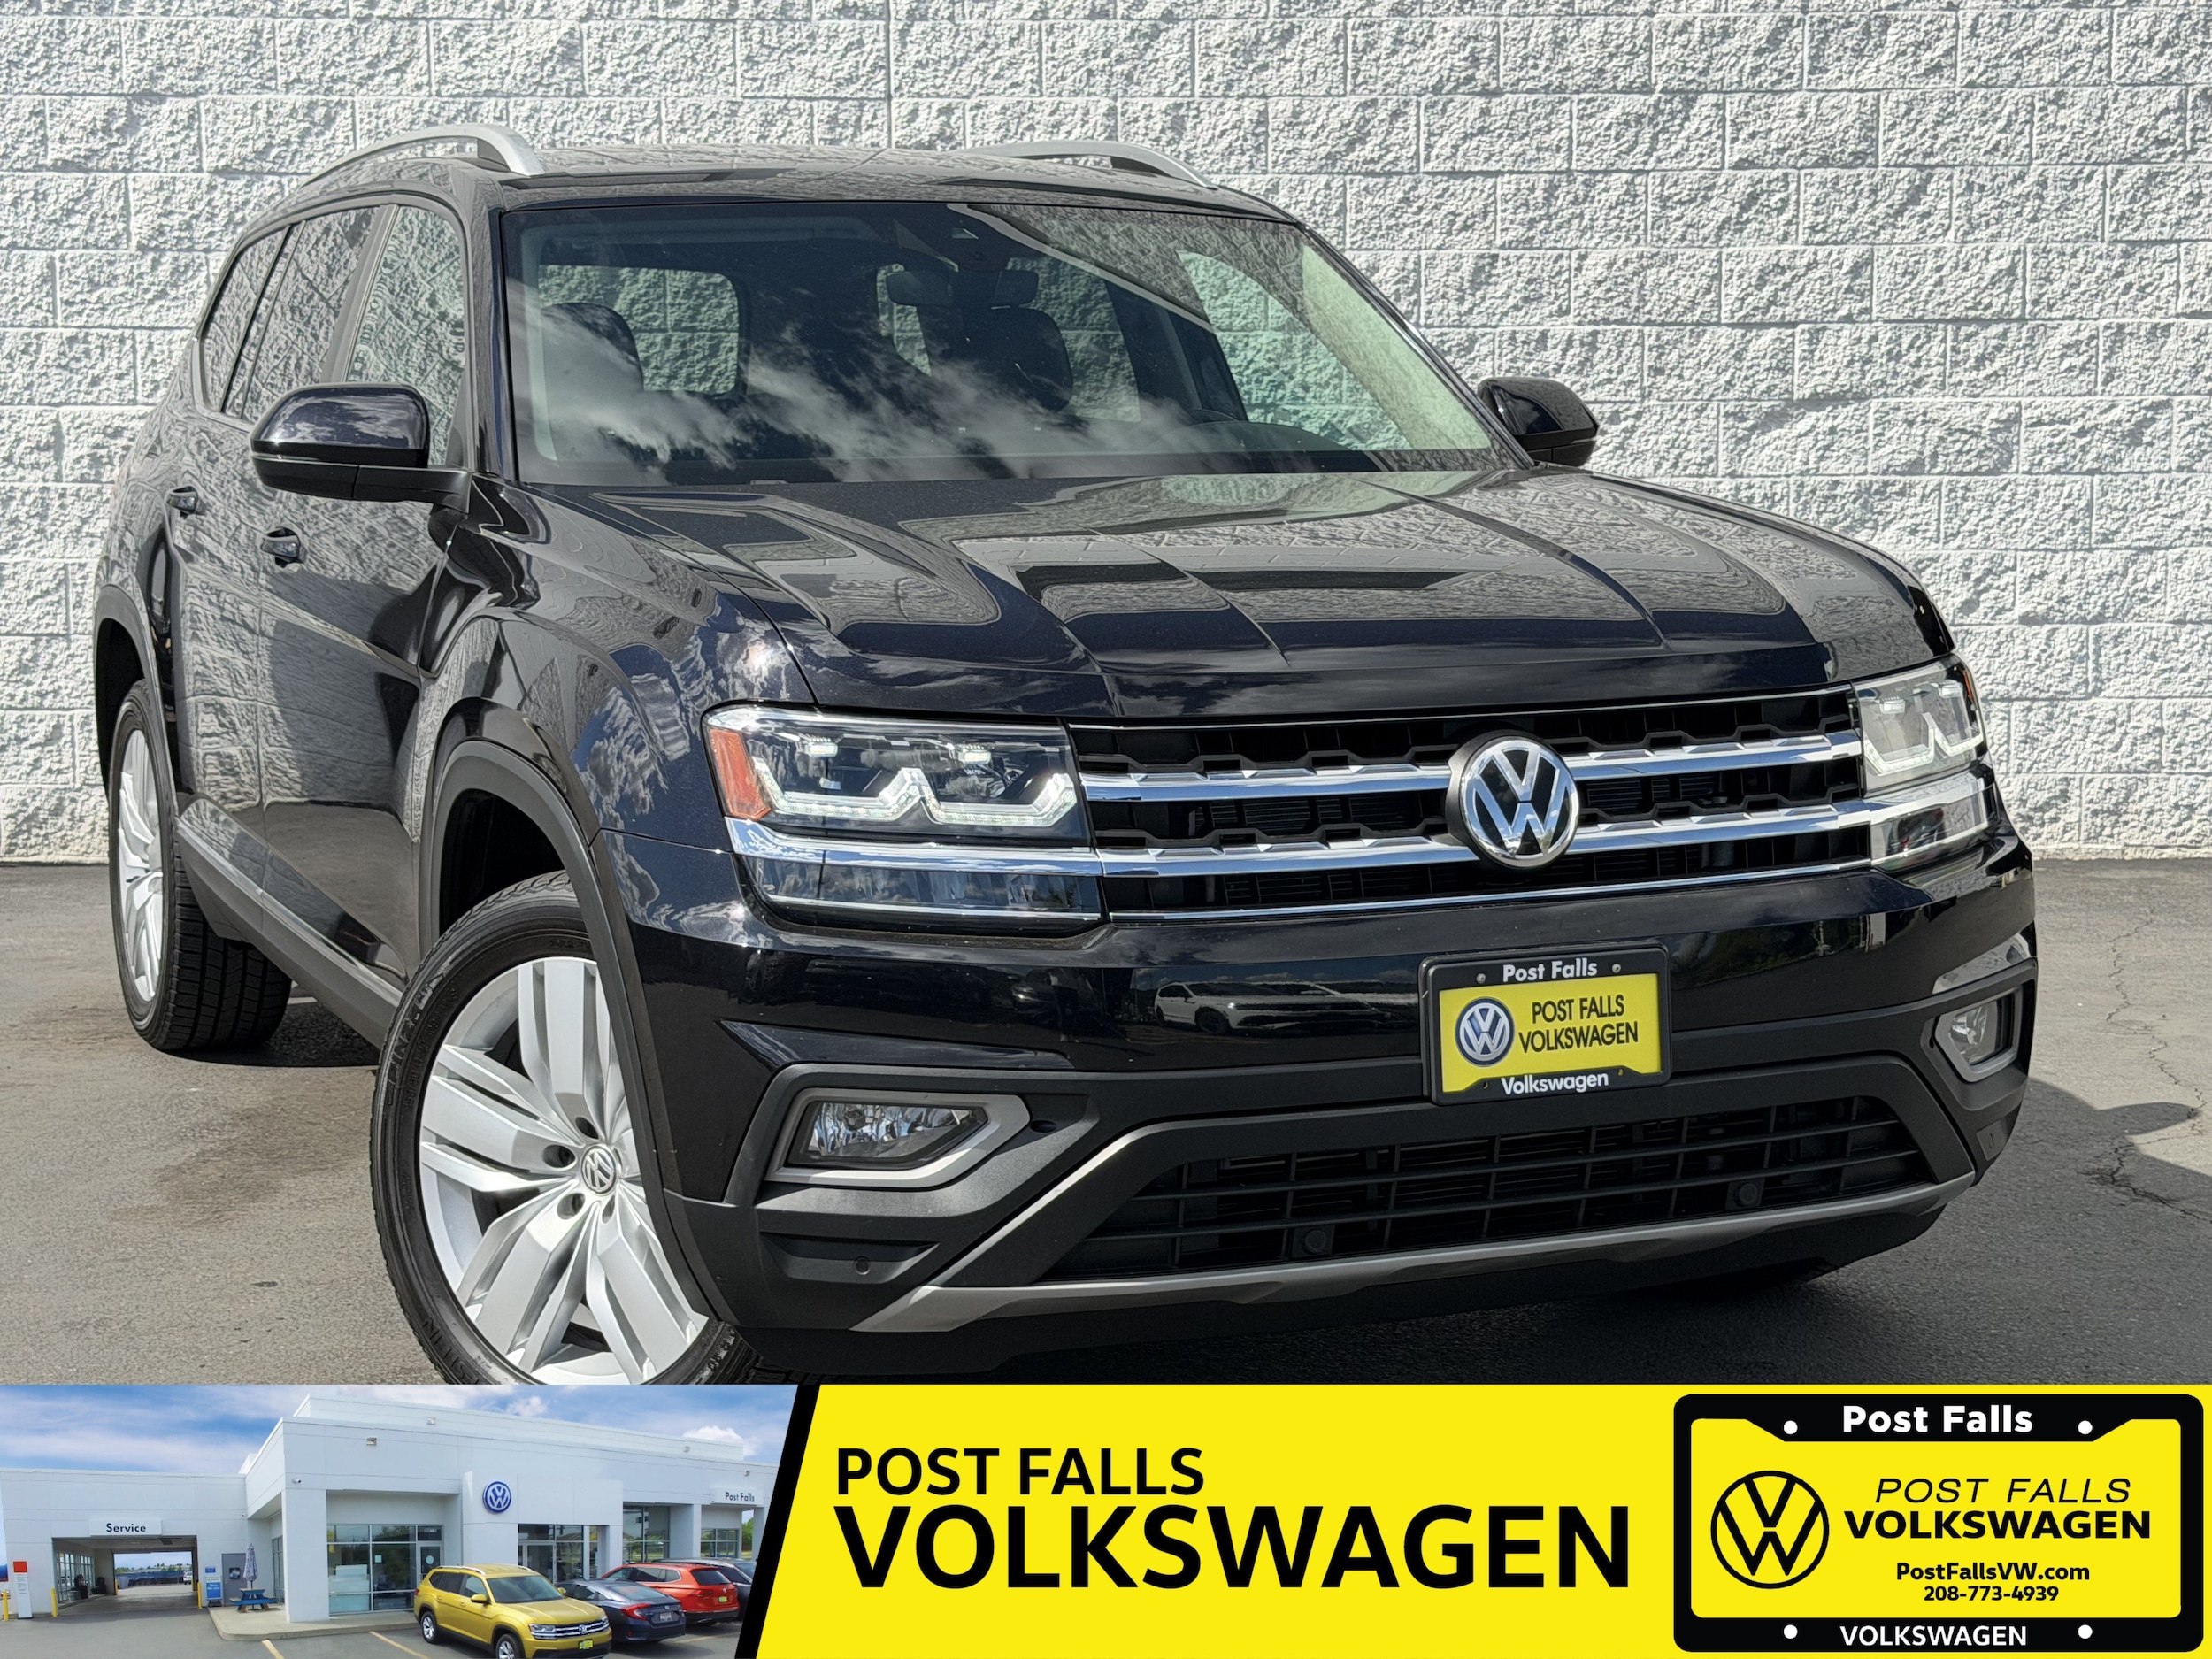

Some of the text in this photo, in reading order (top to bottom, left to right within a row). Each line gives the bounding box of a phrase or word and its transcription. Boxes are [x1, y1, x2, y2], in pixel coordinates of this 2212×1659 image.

[1502, 957, 1598, 983] Post Falls
[1532, 994, 1624, 1024] POST FALLS
[1518, 1021, 1639, 1053] VOLKSWAGEN
[1501, 1072, 1609, 1095] Volkswagen
[725, 1491, 755, 1502] Post Falls
[106, 1523, 146, 1532] Service
